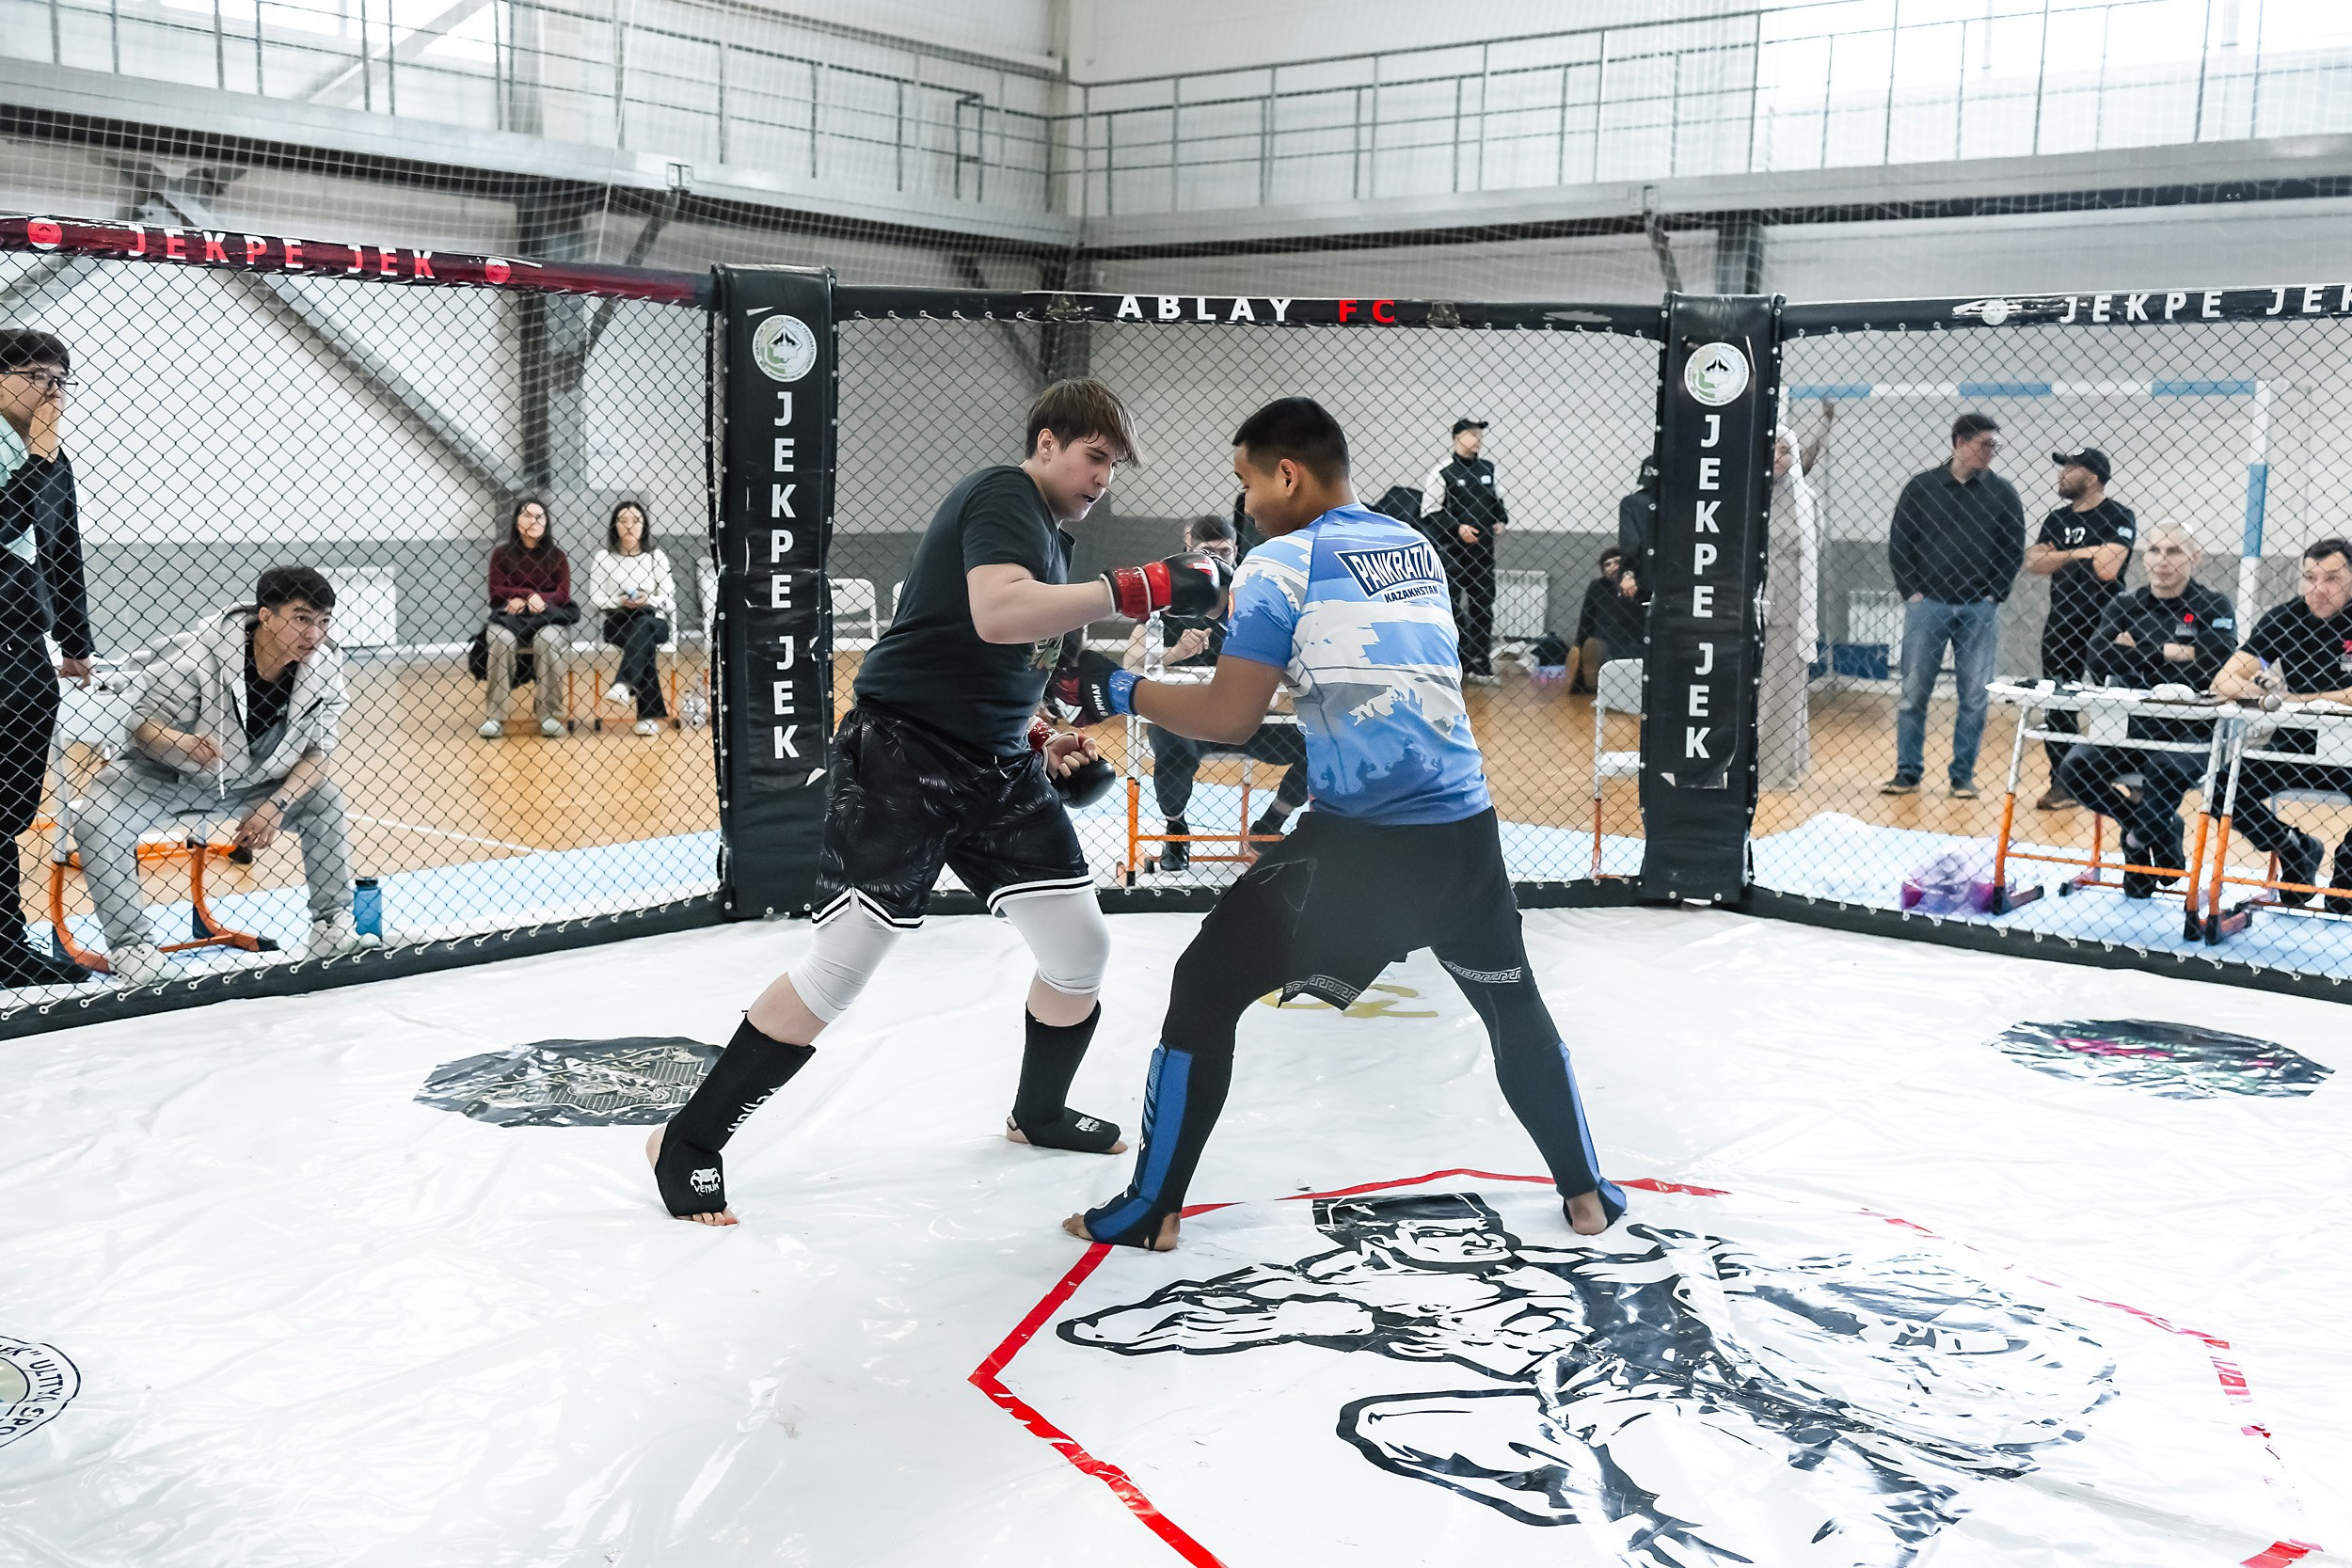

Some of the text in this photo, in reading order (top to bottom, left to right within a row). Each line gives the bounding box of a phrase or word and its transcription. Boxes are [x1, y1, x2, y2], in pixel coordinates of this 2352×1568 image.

[128, 223, 436, 279] JEKPE JEK
[1117, 294, 1395, 324] ABLAY FC
[2059, 290, 2223, 324] JEKPE
[771, 391, 797, 609] JEKPE
[1692, 414, 1722, 618] JEKPE
[1348, 543, 1444, 593] PANKRATION
[1384, 585, 1438, 603] KAZAKHSTAN
[773, 635, 800, 759] JEK
[1091, 683, 1105, 711] IMMAF
[1685, 642, 1714, 759] JEK
[693, 1182, 720, 1194] VENUM
